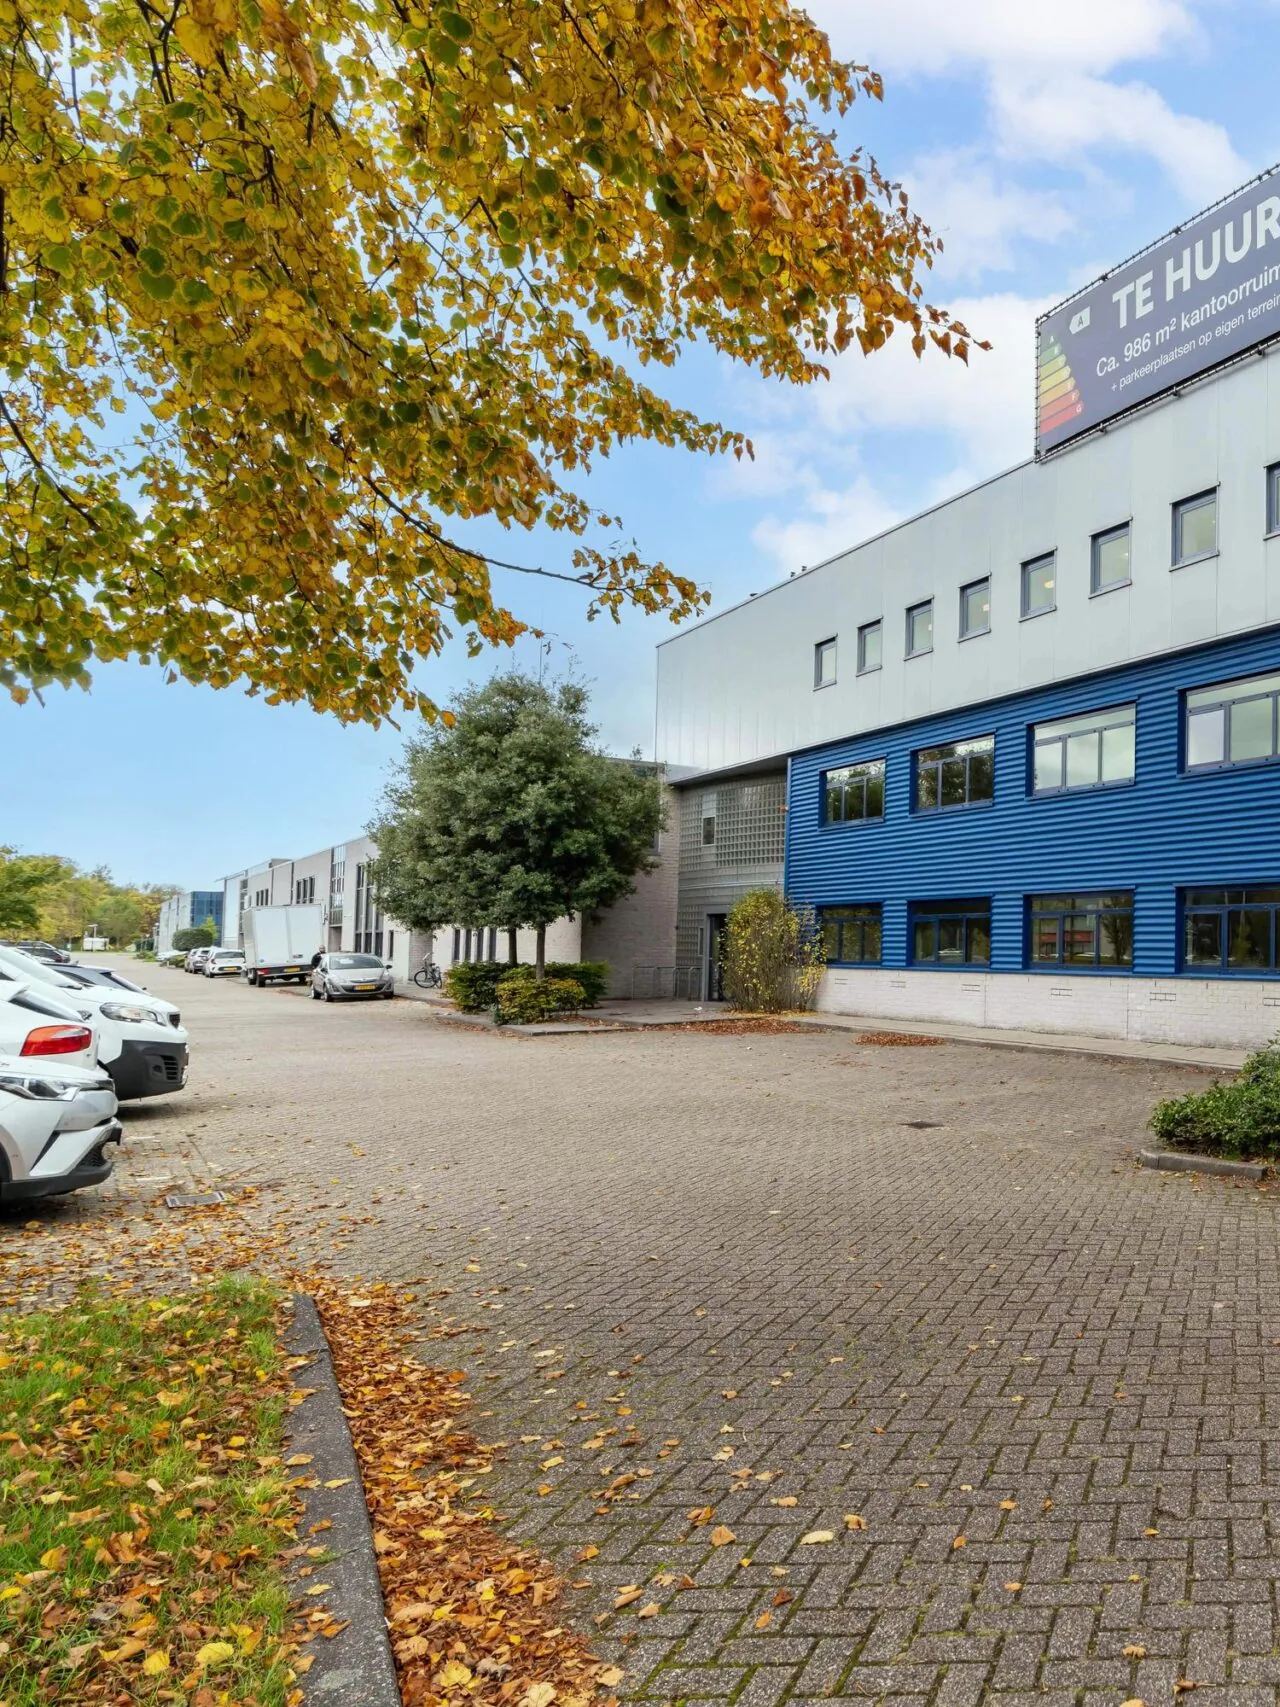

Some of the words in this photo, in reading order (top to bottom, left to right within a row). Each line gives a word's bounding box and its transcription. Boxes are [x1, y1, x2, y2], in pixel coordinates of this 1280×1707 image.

[1078, 316, 1083, 327] A
[1112, 270, 1154, 329] TE
[1096, 357, 1120, 376] Ca.
[1124, 333, 1152, 362] 986
[1111, 383, 1118, 392] +
[1120, 340, 1196, 390] parkeerplaatsen
[1198, 332, 1212, 350] op
[1215, 315, 1244, 338] eigen
